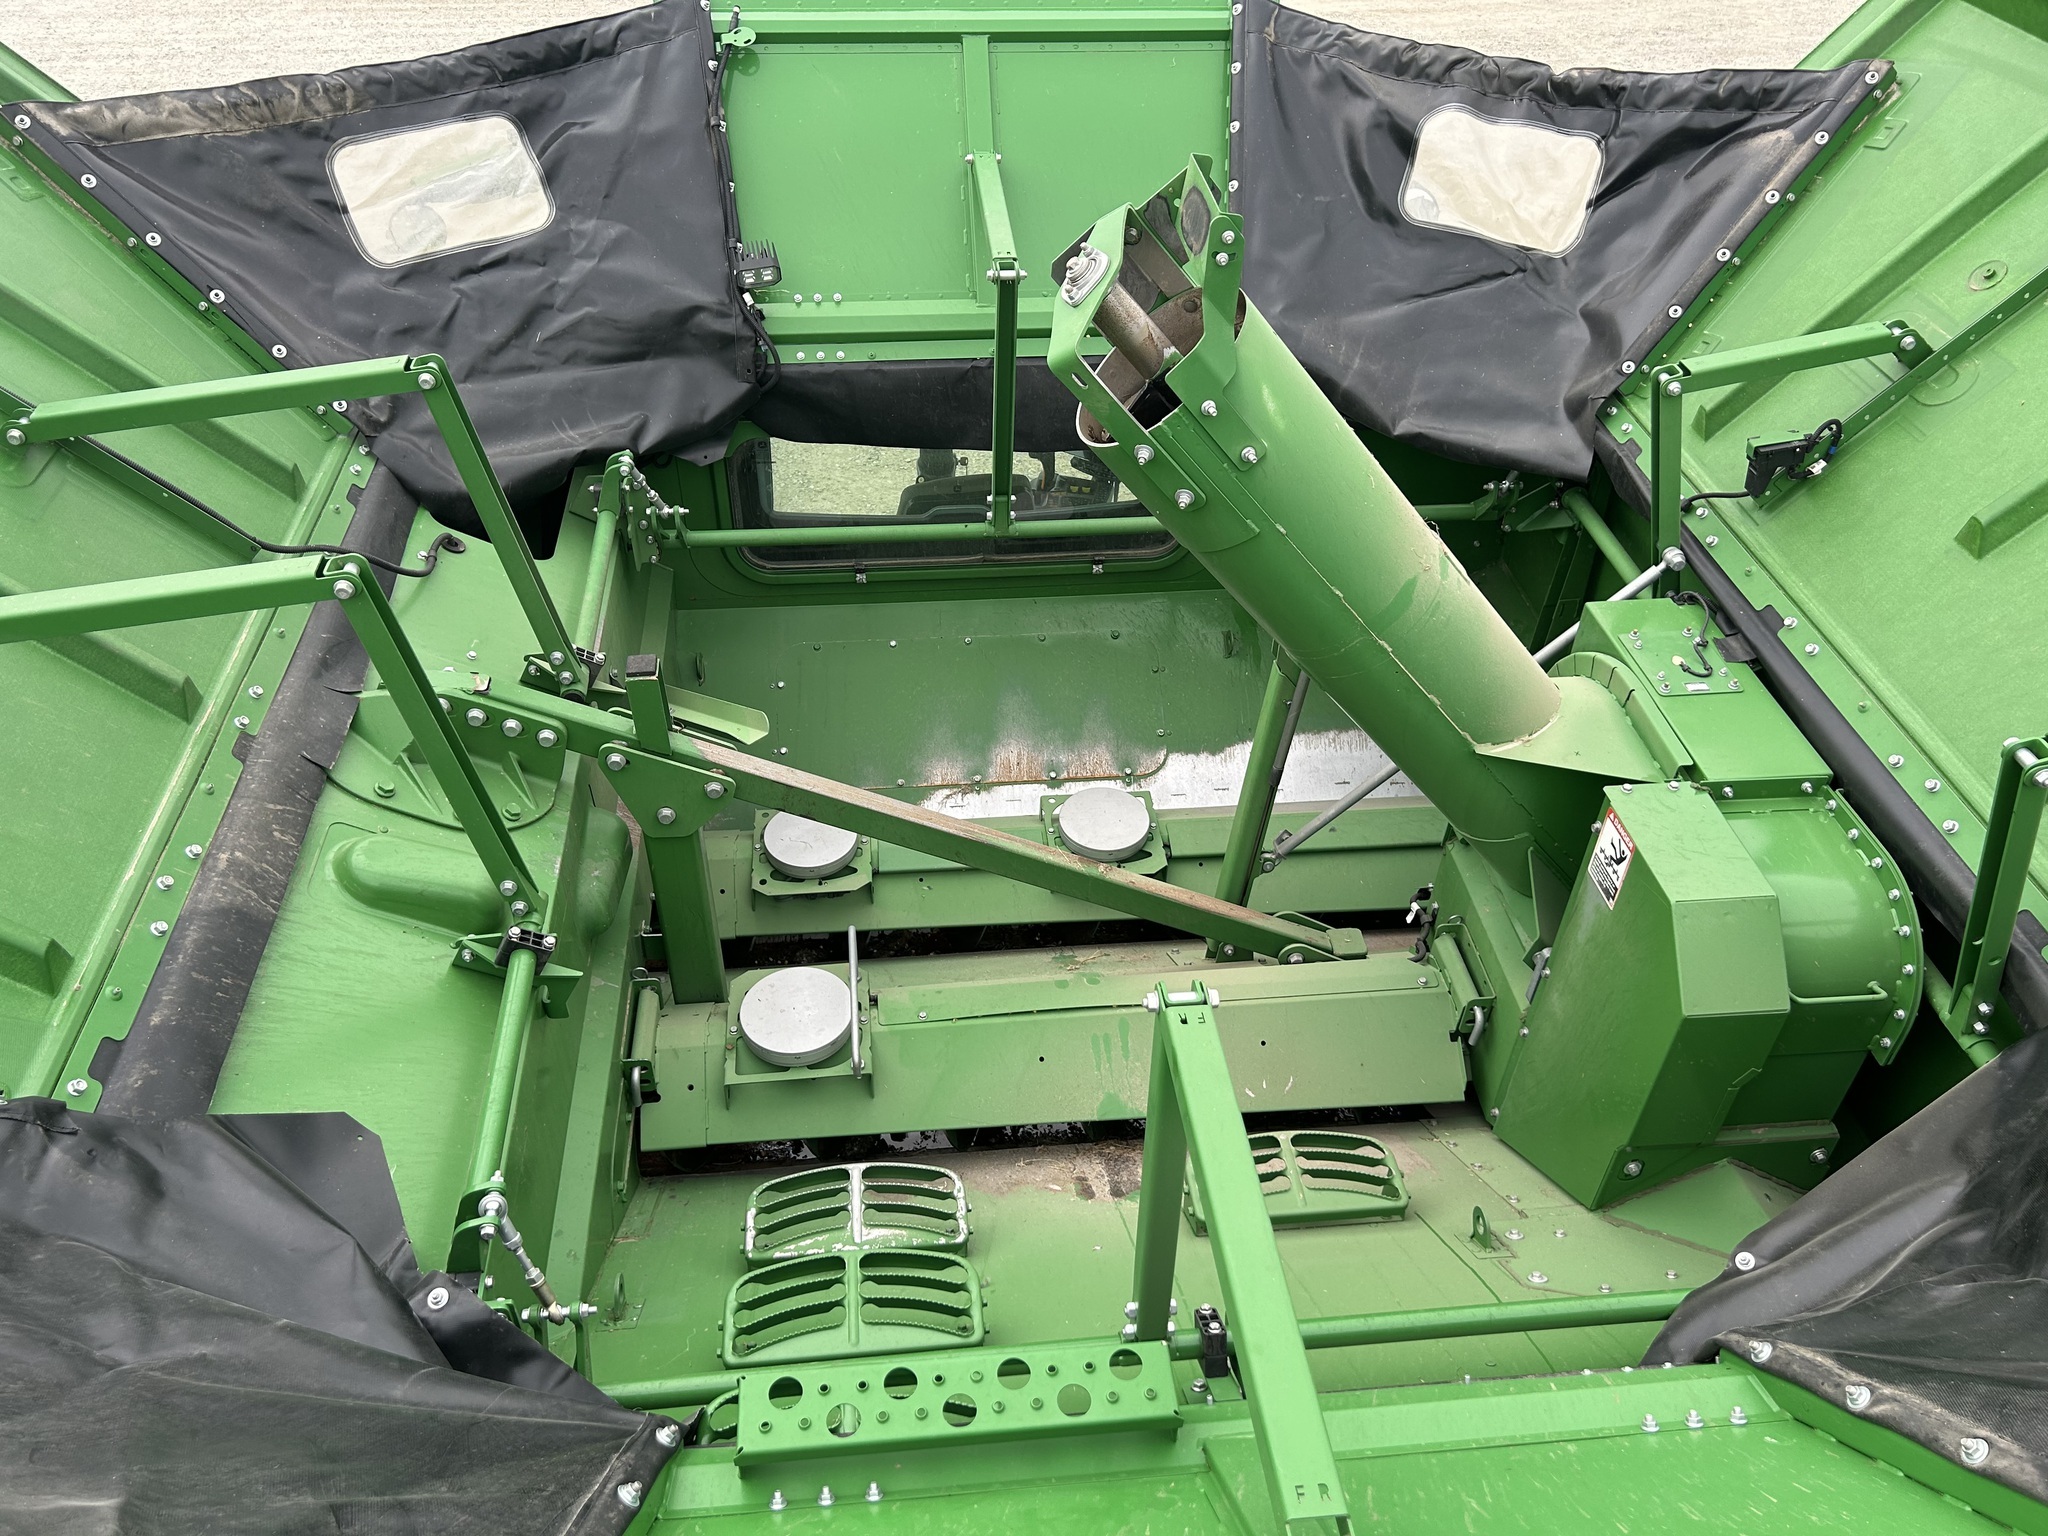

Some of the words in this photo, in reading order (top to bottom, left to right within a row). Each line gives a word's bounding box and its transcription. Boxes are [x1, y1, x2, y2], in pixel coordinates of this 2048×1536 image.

[1613, 818, 1634, 851] DANGER
[1294, 1484, 1305, 1505] F
[1317, 1483, 1332, 1501] R
